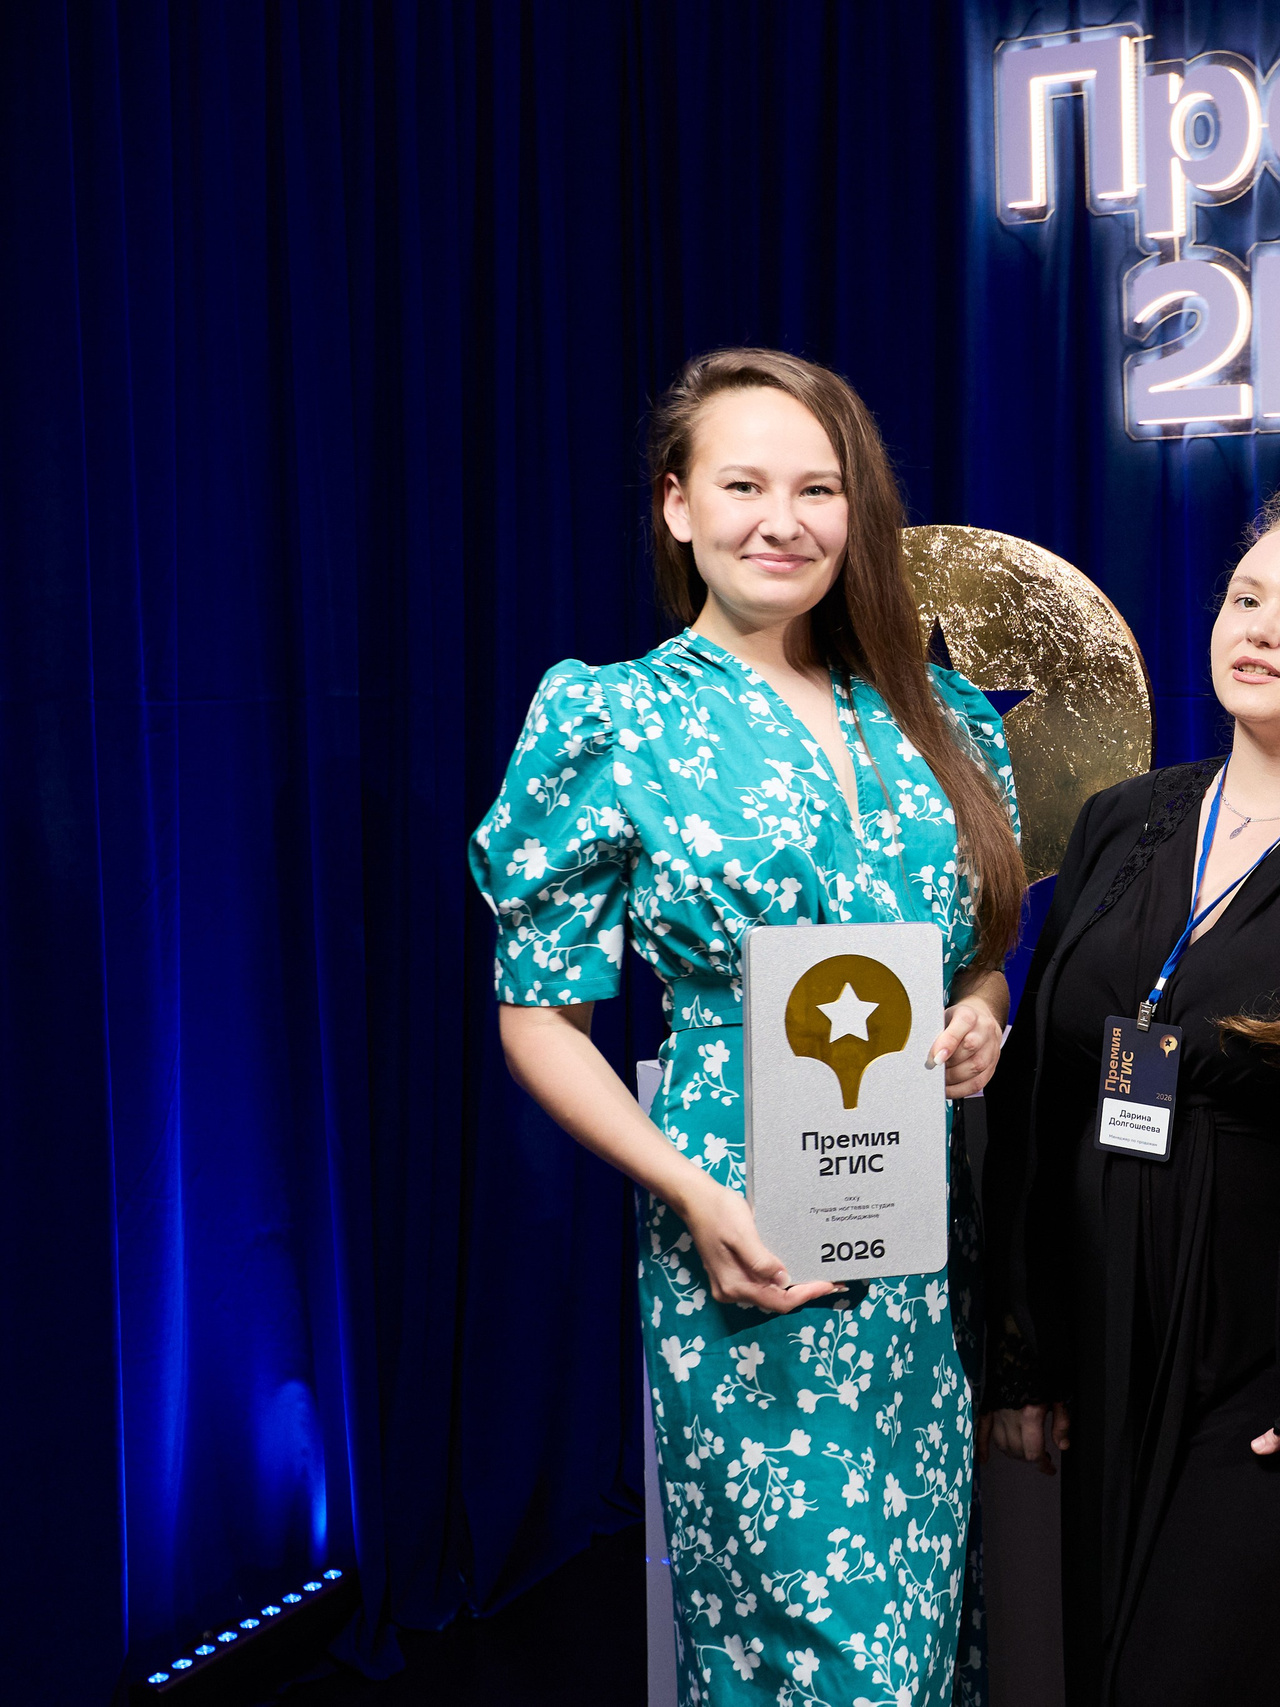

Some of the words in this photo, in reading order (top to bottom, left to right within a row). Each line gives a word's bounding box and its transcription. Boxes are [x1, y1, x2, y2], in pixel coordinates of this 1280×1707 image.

[1104, 1027, 1122, 1092] Премия
[1118, 1050, 1135, 1095] 2ГИС
[1155, 1092, 1173, 1102] 2026
[1108, 1117, 1161, 1134] Долгошеева
[1119, 1109, 1152, 1122] Дарина
[801, 1131, 901, 1155] Премия
[819, 1153, 885, 1177] 2ГИС
[809, 1206, 838, 1215] Лучшая
[871, 1202, 896, 1210] студия
[831, 1212, 880, 1223] Биробиджане
[820, 1238, 886, 1264] 2026
